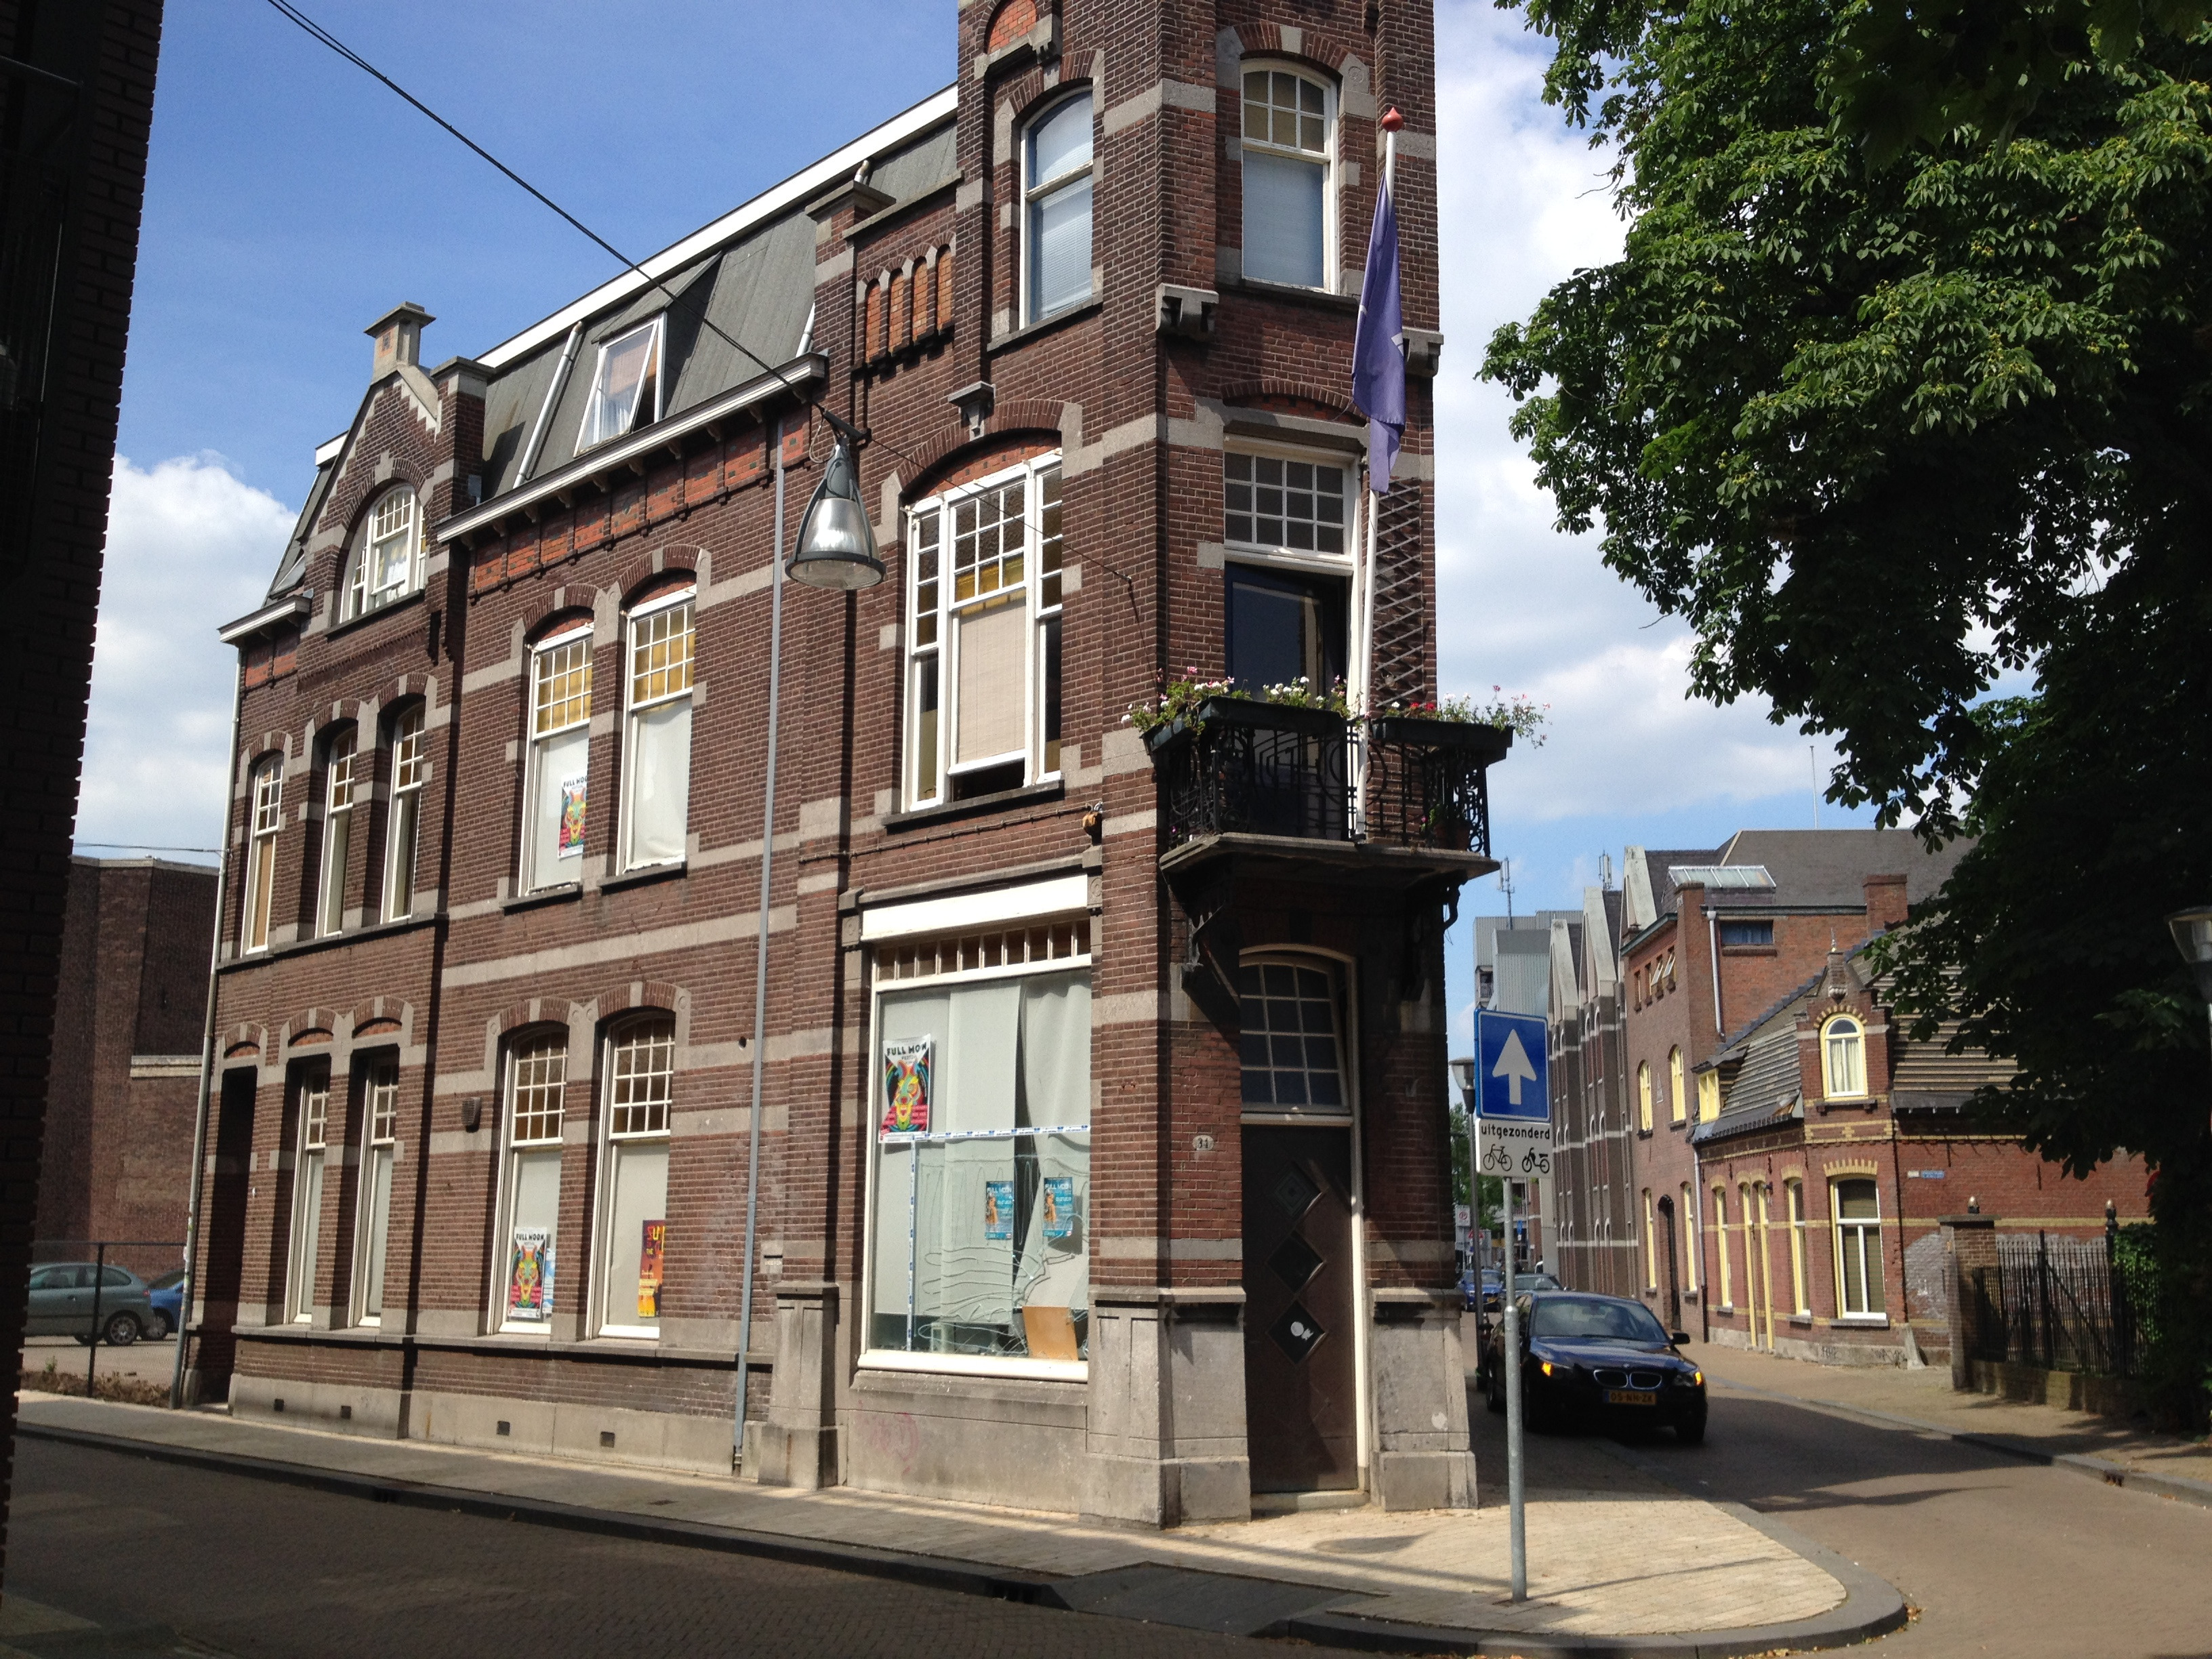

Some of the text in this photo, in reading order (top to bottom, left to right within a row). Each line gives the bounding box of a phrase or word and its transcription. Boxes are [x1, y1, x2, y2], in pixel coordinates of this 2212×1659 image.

[563, 779, 575, 787] FULL
[576, 776, 588, 784] MOO
[886, 1046, 906, 1056] FULL
[1481, 1124, 1550, 1140] uitgezonderd
